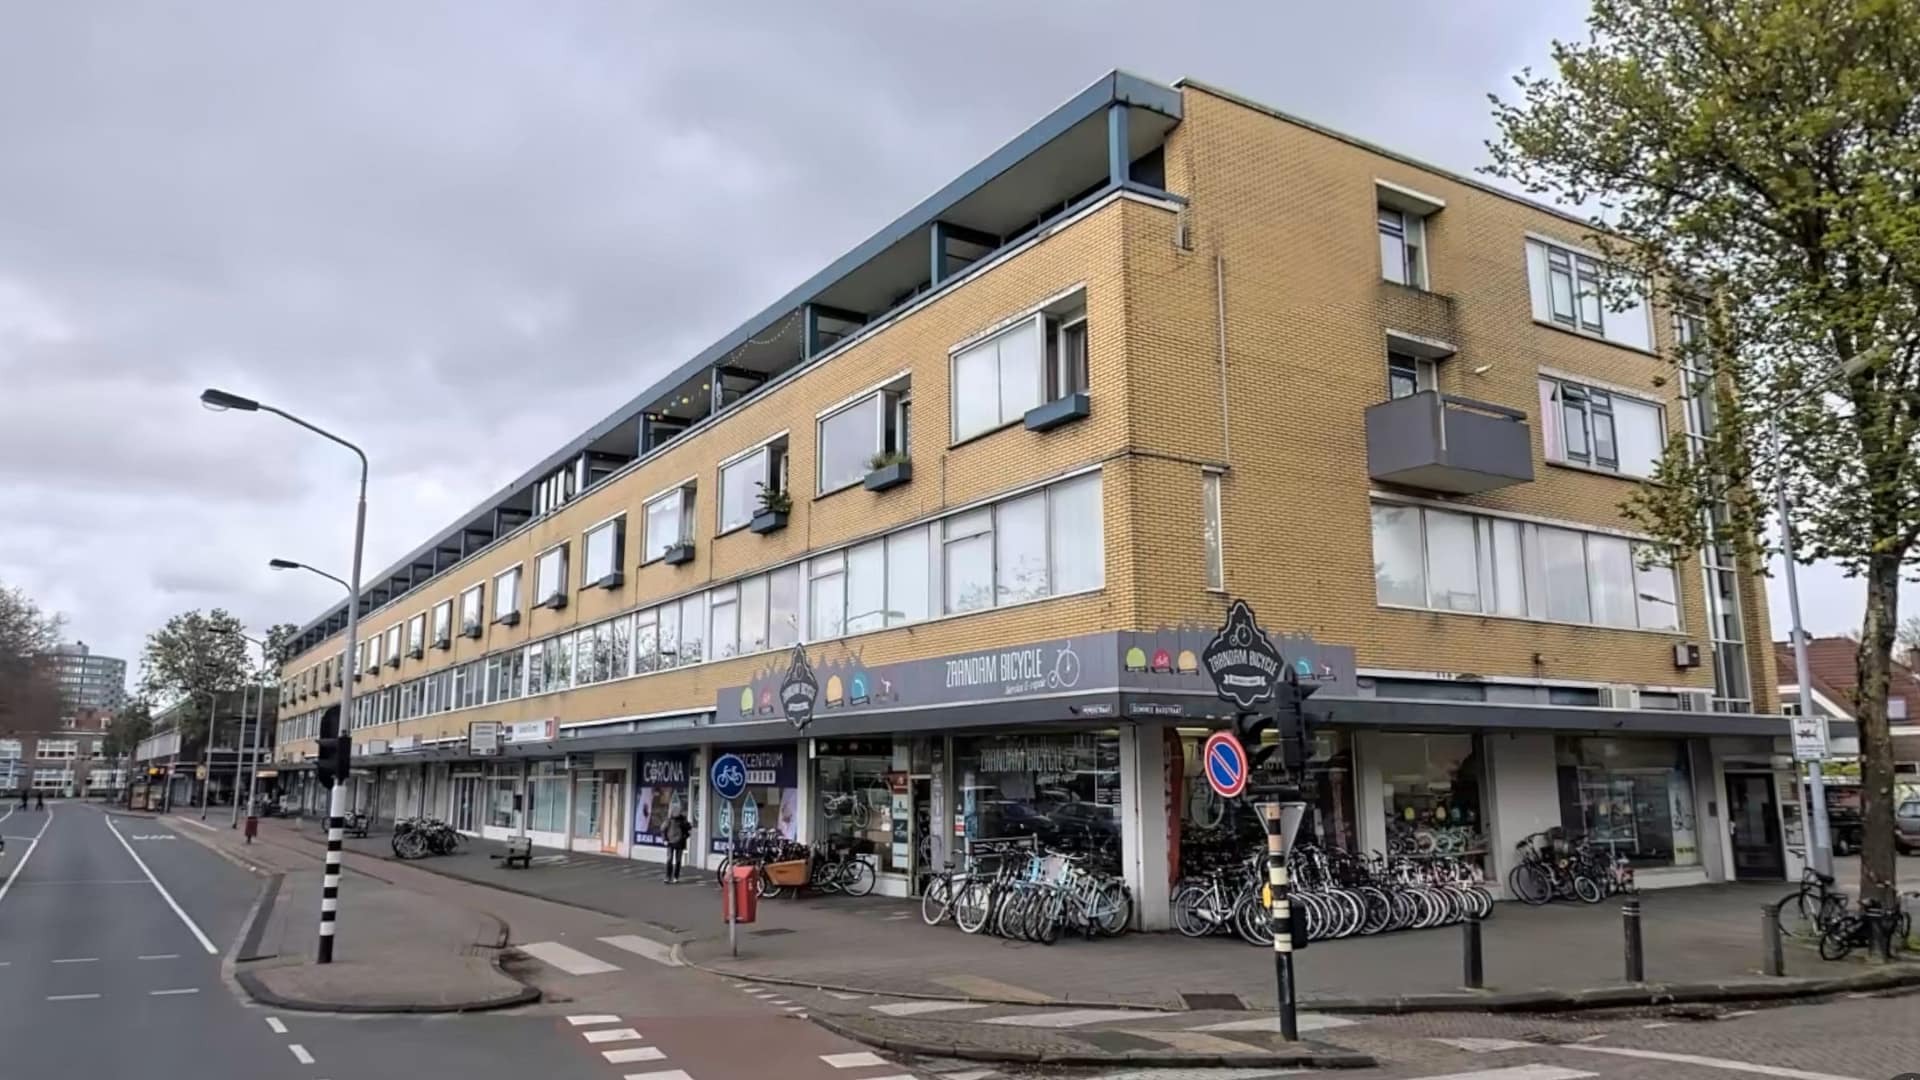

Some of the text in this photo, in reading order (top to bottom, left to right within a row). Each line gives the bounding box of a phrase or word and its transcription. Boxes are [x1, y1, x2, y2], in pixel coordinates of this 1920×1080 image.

[945, 648, 1043, 689] ZAANDAM BICYCLE
[1208, 649, 1279, 676] ZAANDAM BICYCLE
[643, 760, 685, 783] CORONA
